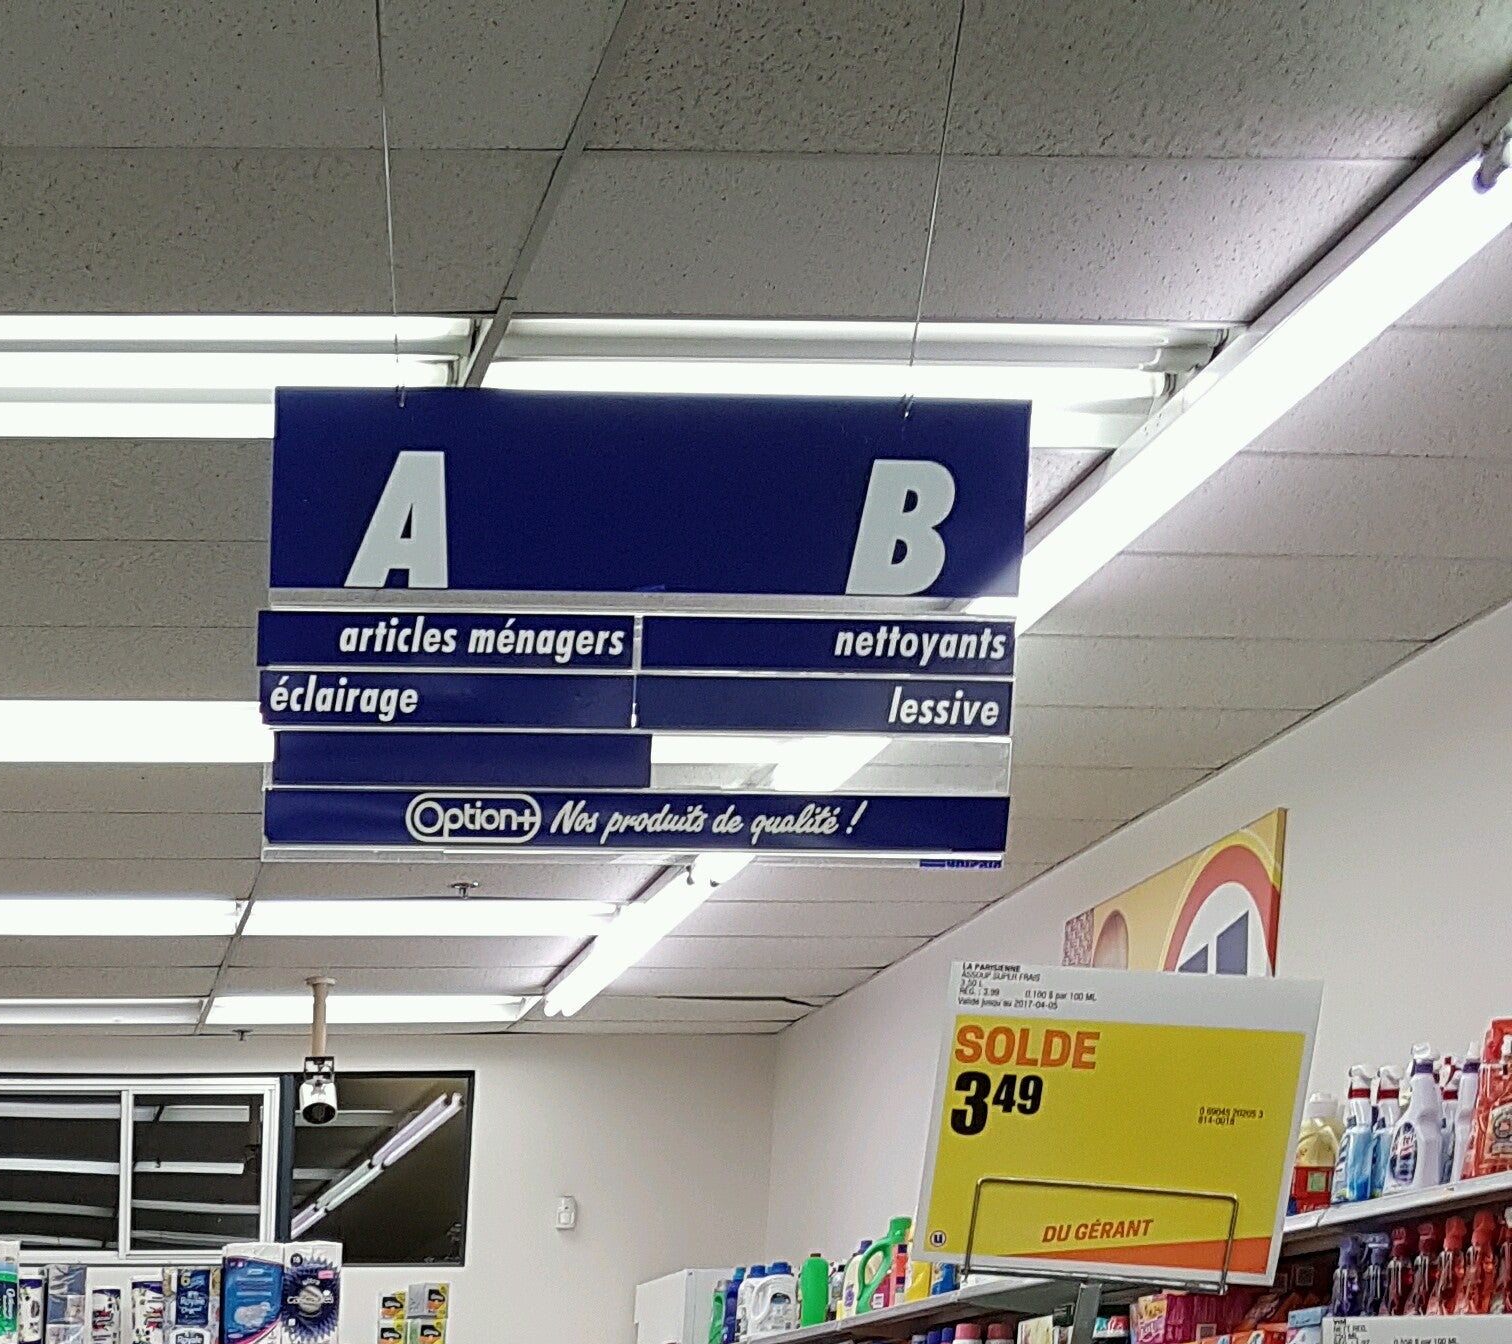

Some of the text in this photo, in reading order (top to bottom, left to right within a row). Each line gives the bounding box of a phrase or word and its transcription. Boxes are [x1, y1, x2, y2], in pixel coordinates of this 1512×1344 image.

[344, 450, 448, 589] A
[846, 458, 957, 595] B
[339, 617, 625, 664] articles ménagers
[834, 627, 1007, 669] nettoyants
[269, 676, 420, 722] éclairage
[888, 688, 1000, 727] lessive
[550, 800, 842, 850] Nos produits de qualité
[1014, 999, 1058, 1010] 2017-04-05
[954, 1024, 1101, 1070] SOLDE
[1042, 1218, 1154, 1243] DU GÉRANT
